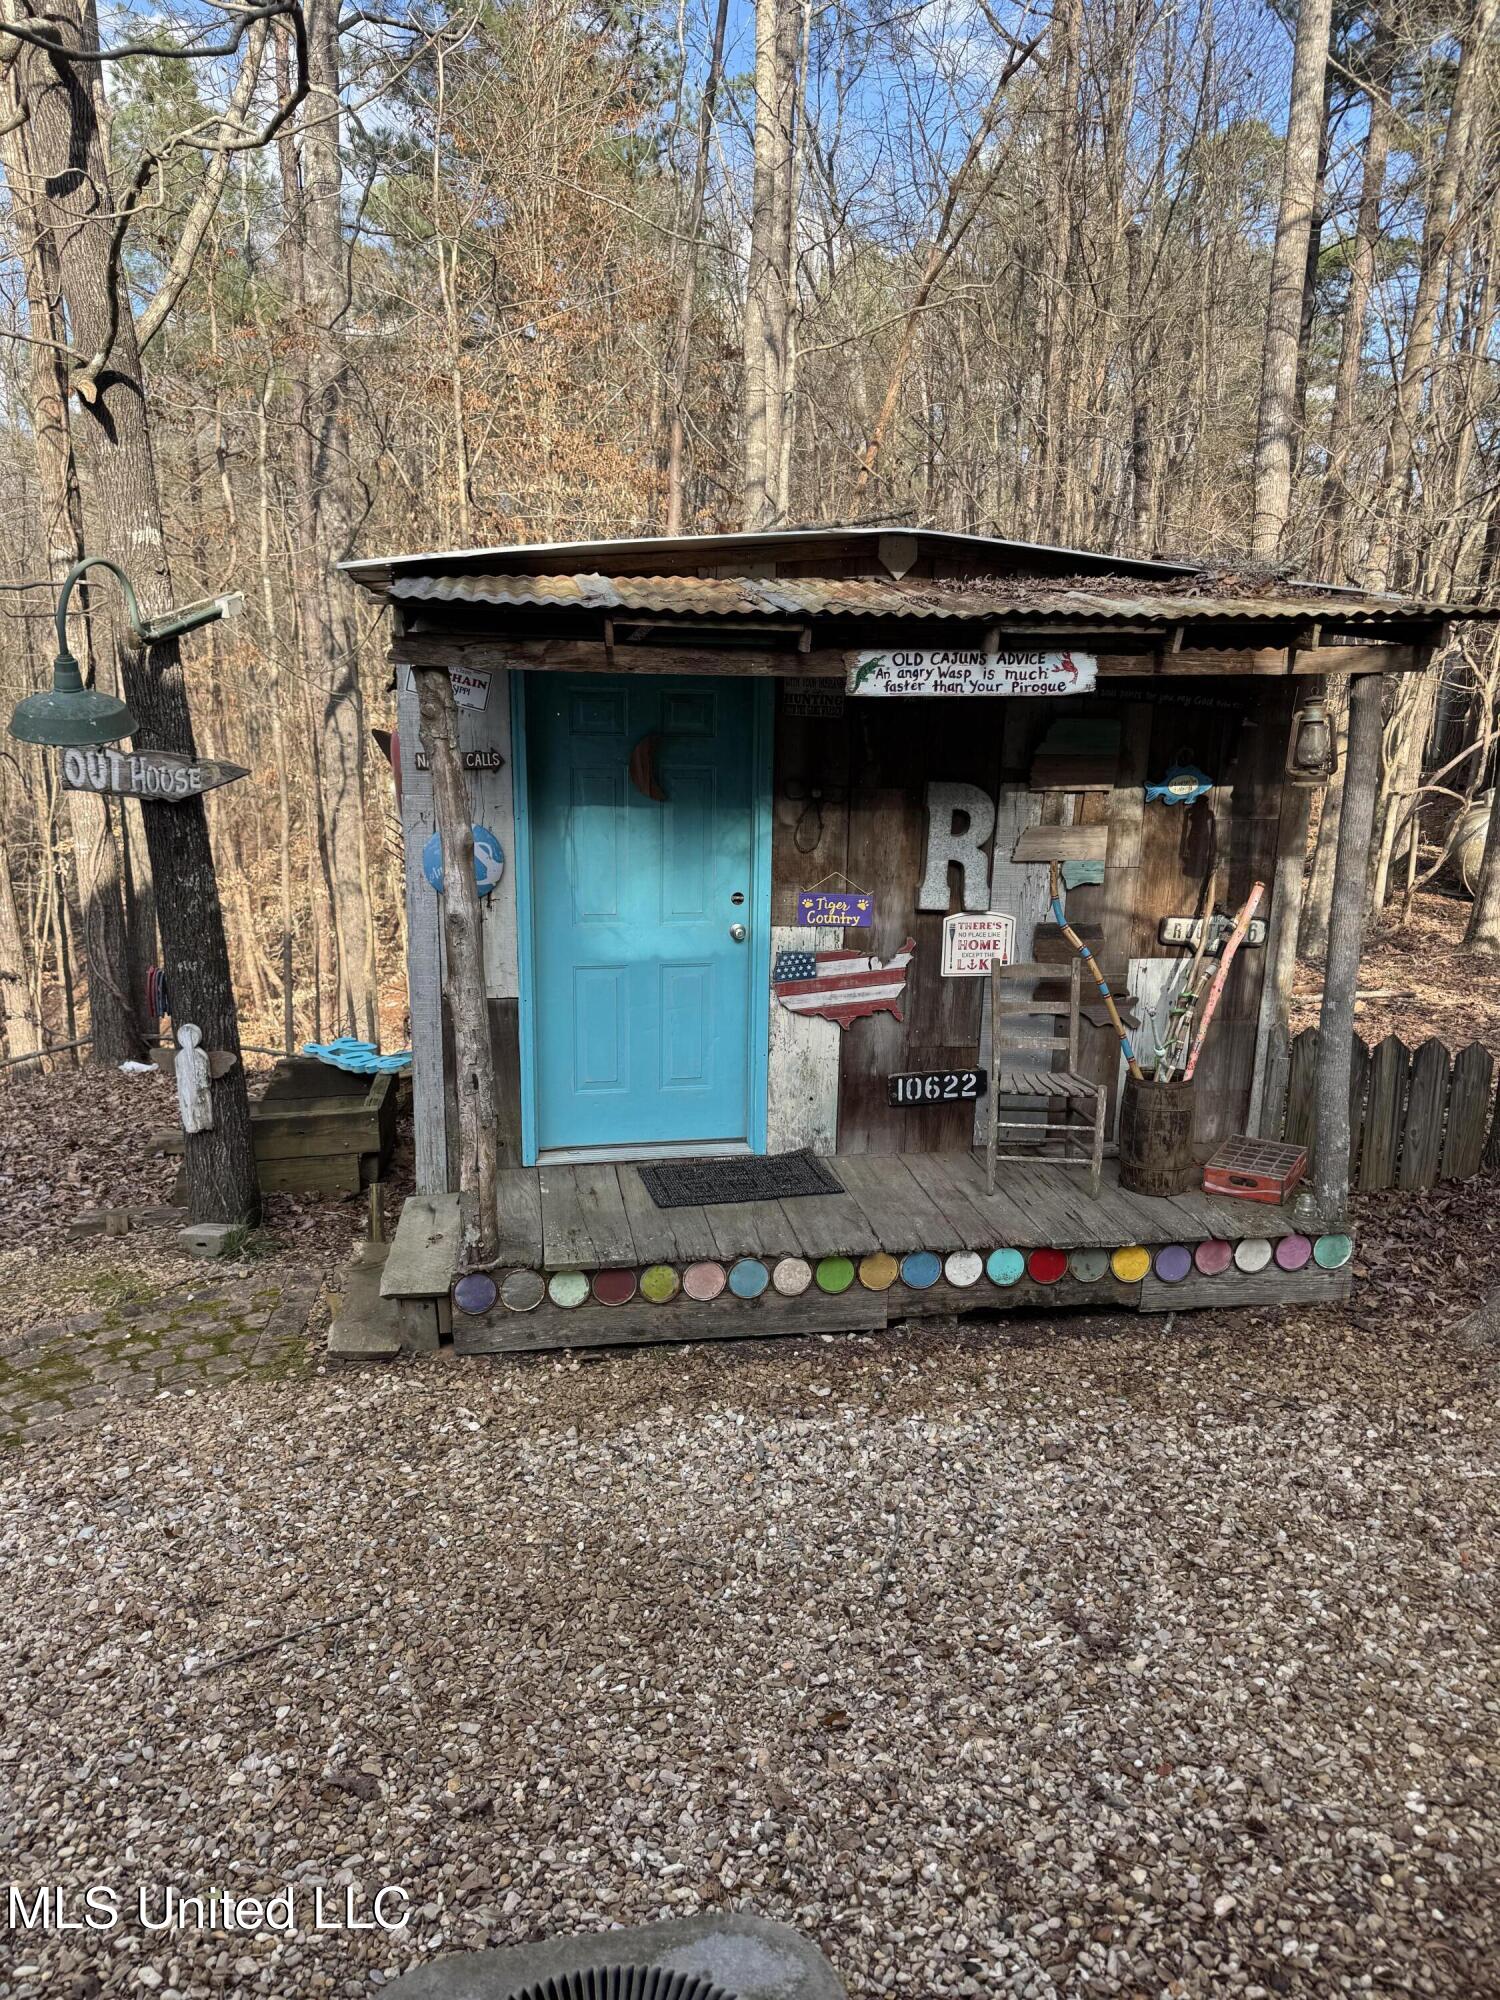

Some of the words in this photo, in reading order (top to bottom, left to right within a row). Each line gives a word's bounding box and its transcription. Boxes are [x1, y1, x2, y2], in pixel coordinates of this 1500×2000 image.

[892, 653, 923, 666] OLD
[930, 652, 986, 666] CAJUNS
[997, 653, 1046, 666] ADVICE
[875, 668, 890, 680] An
[897, 668, 934, 682] angry
[938, 668, 972, 683] Wasp
[983, 668, 995, 680] is
[1005, 667, 1049, 680] much
[884, 681, 925, 693] faster
[932, 681, 964, 693] than
[969, 681, 1003, 693] Your
[1011, 681, 1067, 695] Pirogue
[466, 753, 500, 766] CALLS
[64, 748, 123, 791] OUT
[128, 756, 201, 794] HOUSE
[919, 781, 995, 911] R
[815, 896, 851, 914] Tiger
[806, 910, 861, 926] Country
[957, 921, 1002, 930] THERE'S
[957, 939, 1001, 950] HOME
[898, 1073, 977, 1102] 10622
